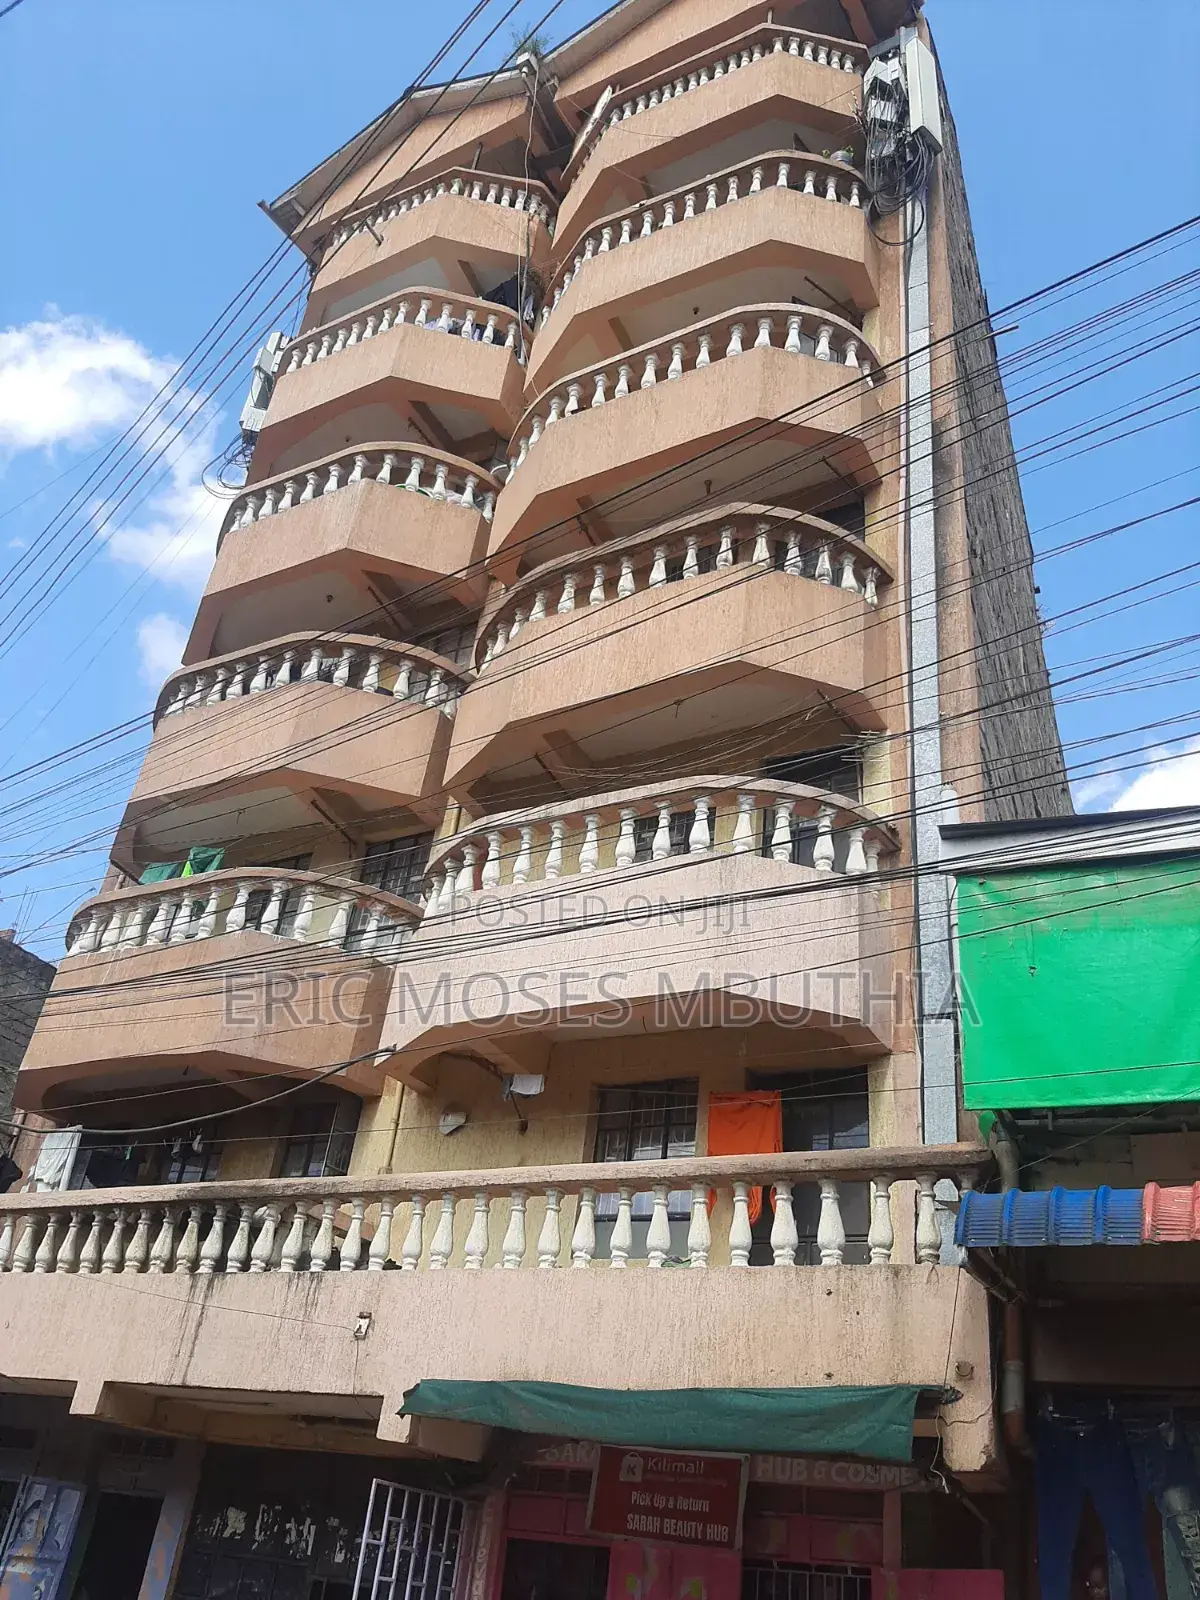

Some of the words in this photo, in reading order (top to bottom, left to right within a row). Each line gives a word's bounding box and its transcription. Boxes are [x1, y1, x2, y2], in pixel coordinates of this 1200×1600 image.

[647, 1456, 705, 1475] Kilimall
[757, 1455, 807, 1482] HUB
[631, 1490, 651, 1507] Pick
[653, 1492, 666, 1510] Up
[667, 1495, 674, 1508] &
[677, 1495, 710, 1513] Return
[626, 1513, 661, 1534] SARAH
[663, 1517, 703, 1540] BEAUTY
[706, 1523, 729, 1543] HUB
